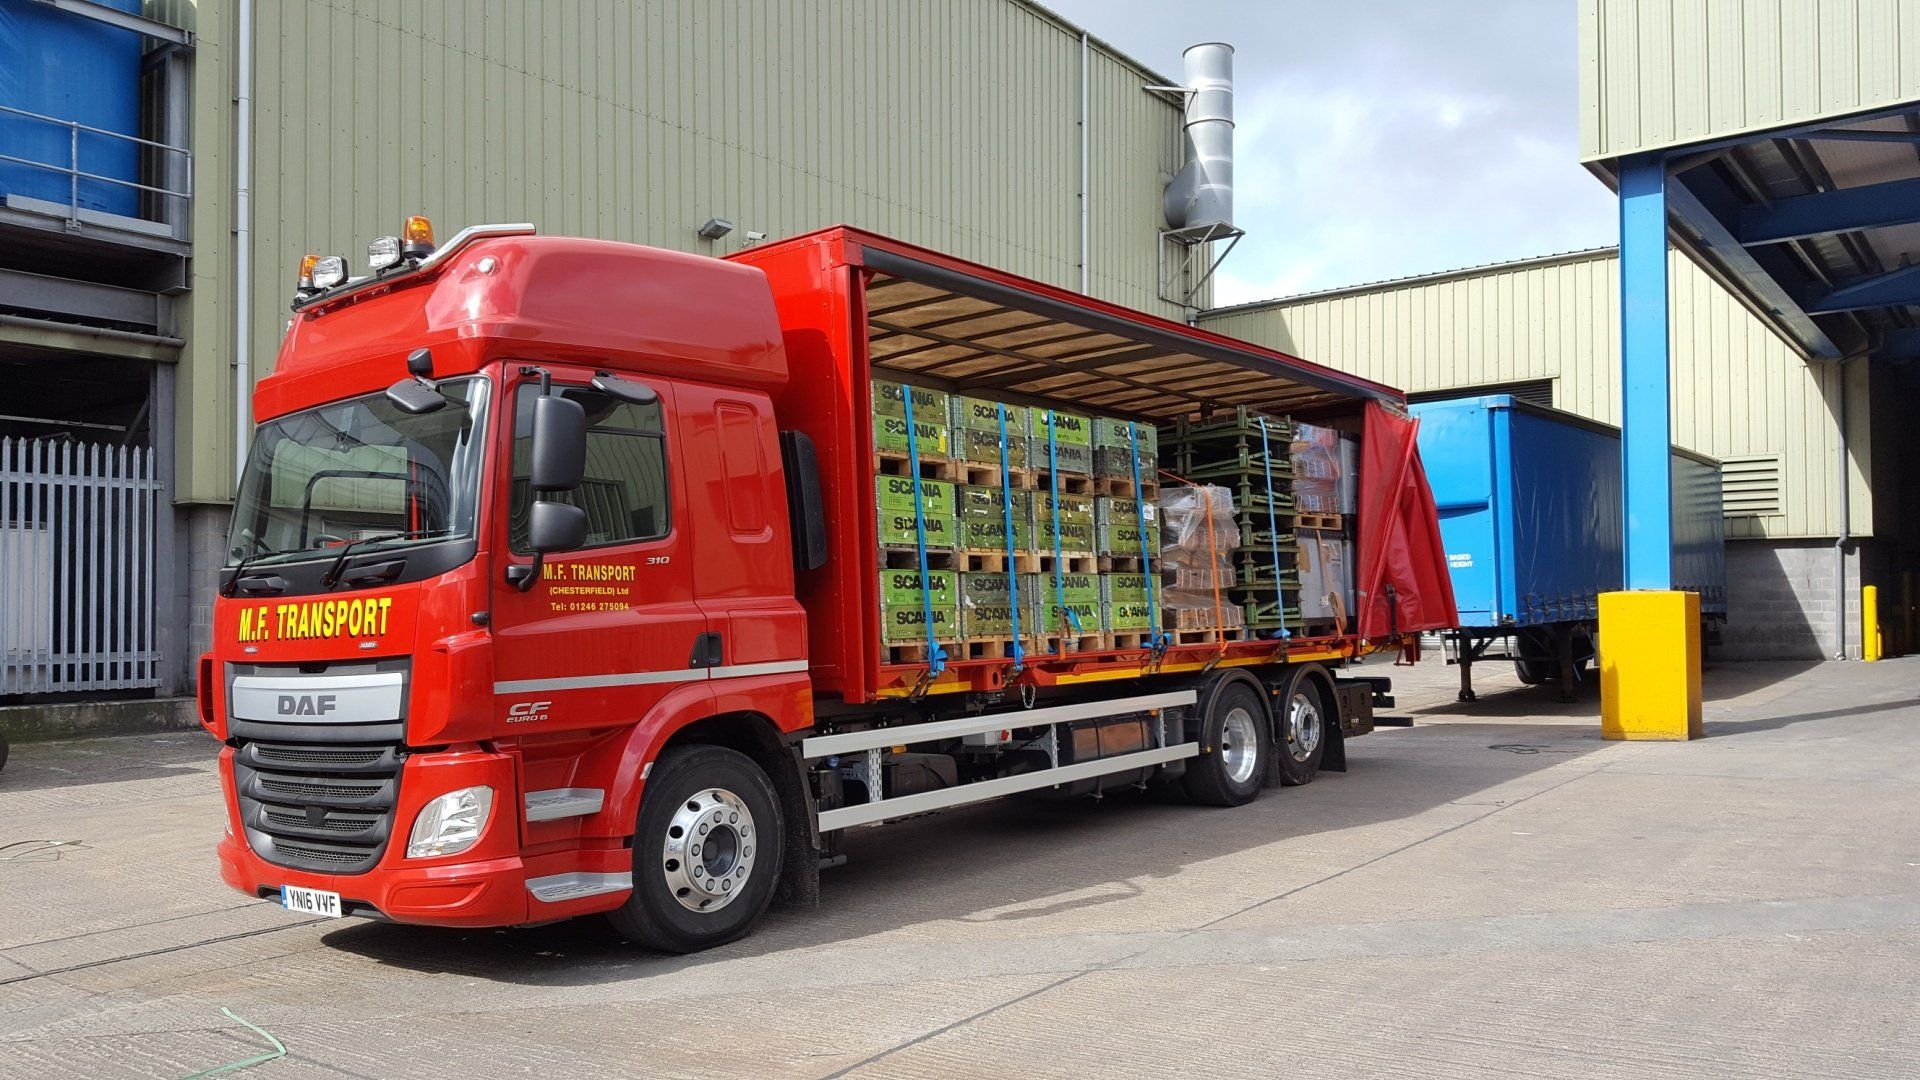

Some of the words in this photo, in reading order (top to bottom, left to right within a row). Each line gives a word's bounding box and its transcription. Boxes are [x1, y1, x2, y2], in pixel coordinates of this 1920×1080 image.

[884, 418, 939, 440] SCNIA
[646, 556, 670, 565] 310
[543, 564, 567, 580] M.F.
[570, 564, 636, 581] TRANSPORT
[549, 586, 615, 596] (CHESTERFIELD)
[616, 587, 629, 595] Ltd
[550, 602, 567, 611] Tel:
[569, 602, 596, 611] 01246
[598, 602, 630, 611] 275094
[238, 607, 269, 643] M.F.
[276, 597, 393, 640] TRANSPORT
[277, 695, 337, 716] DAF
[509, 701, 552, 716] CF
[506, 715, 538, 723] EURO
[314, 892, 336, 914] VVF
